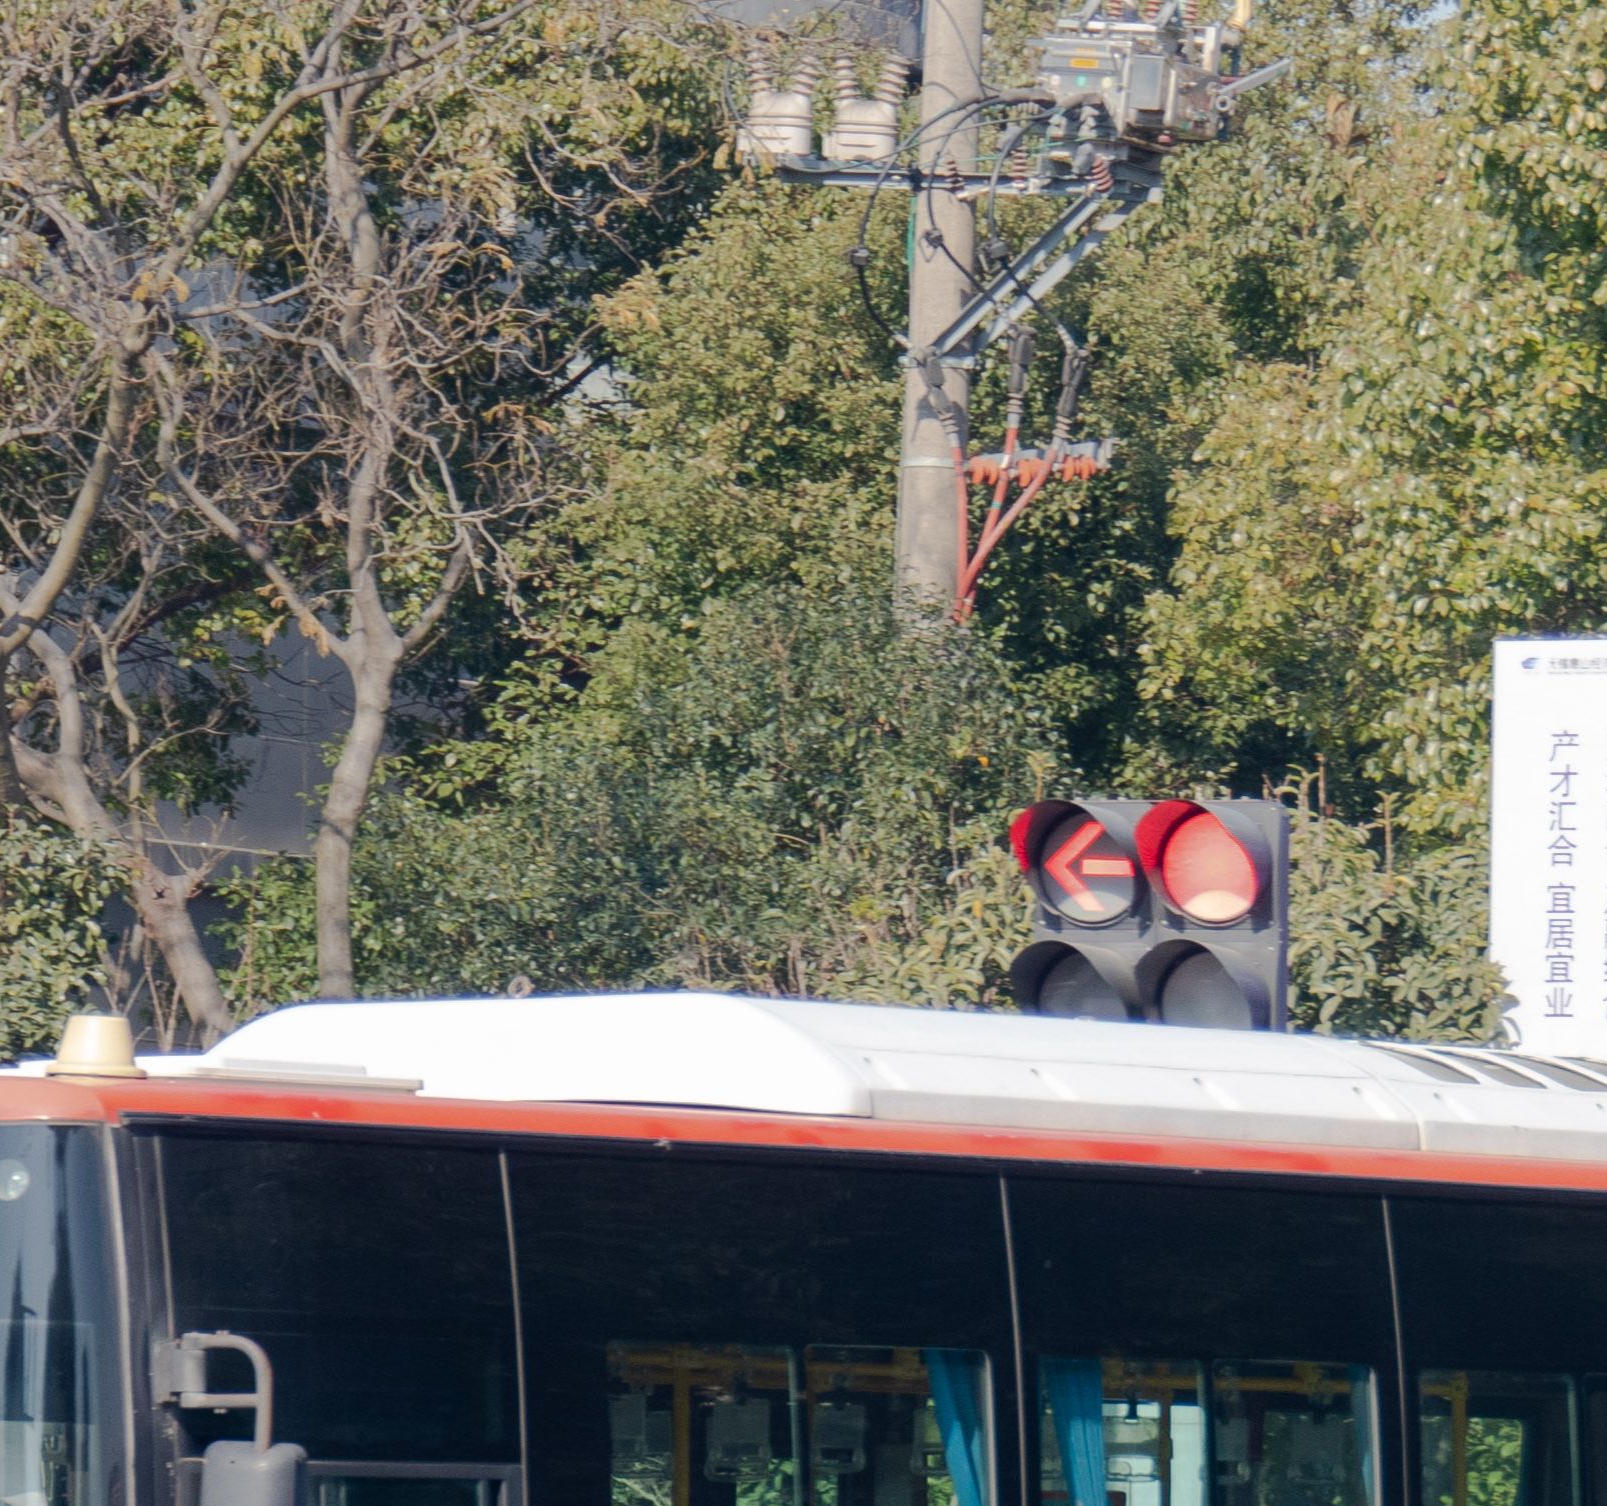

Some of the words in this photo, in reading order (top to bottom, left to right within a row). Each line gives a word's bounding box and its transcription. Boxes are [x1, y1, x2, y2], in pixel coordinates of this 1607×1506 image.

[1546, 729, 1580, 868] 产才汇合
[1544, 882, 1576, 1020] 宜居宜业
